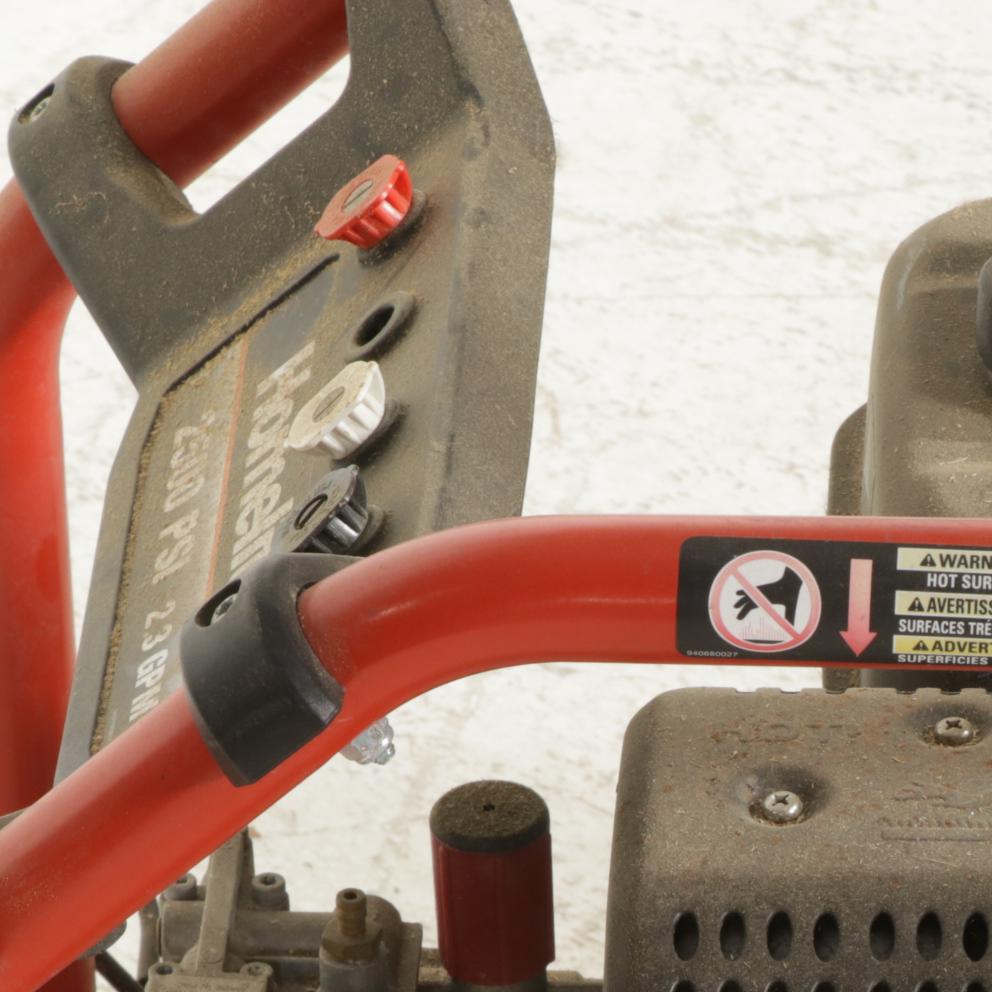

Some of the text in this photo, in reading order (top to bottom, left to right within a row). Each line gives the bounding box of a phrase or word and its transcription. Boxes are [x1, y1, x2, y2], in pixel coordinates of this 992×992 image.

[152, 507, 199, 584] PSI
[927, 572, 958, 588] HOT
[899, 618, 965, 636] SURFACES
[897, 654, 989, 666] SUPERFICIES
[129, 649, 168, 722] GPM
